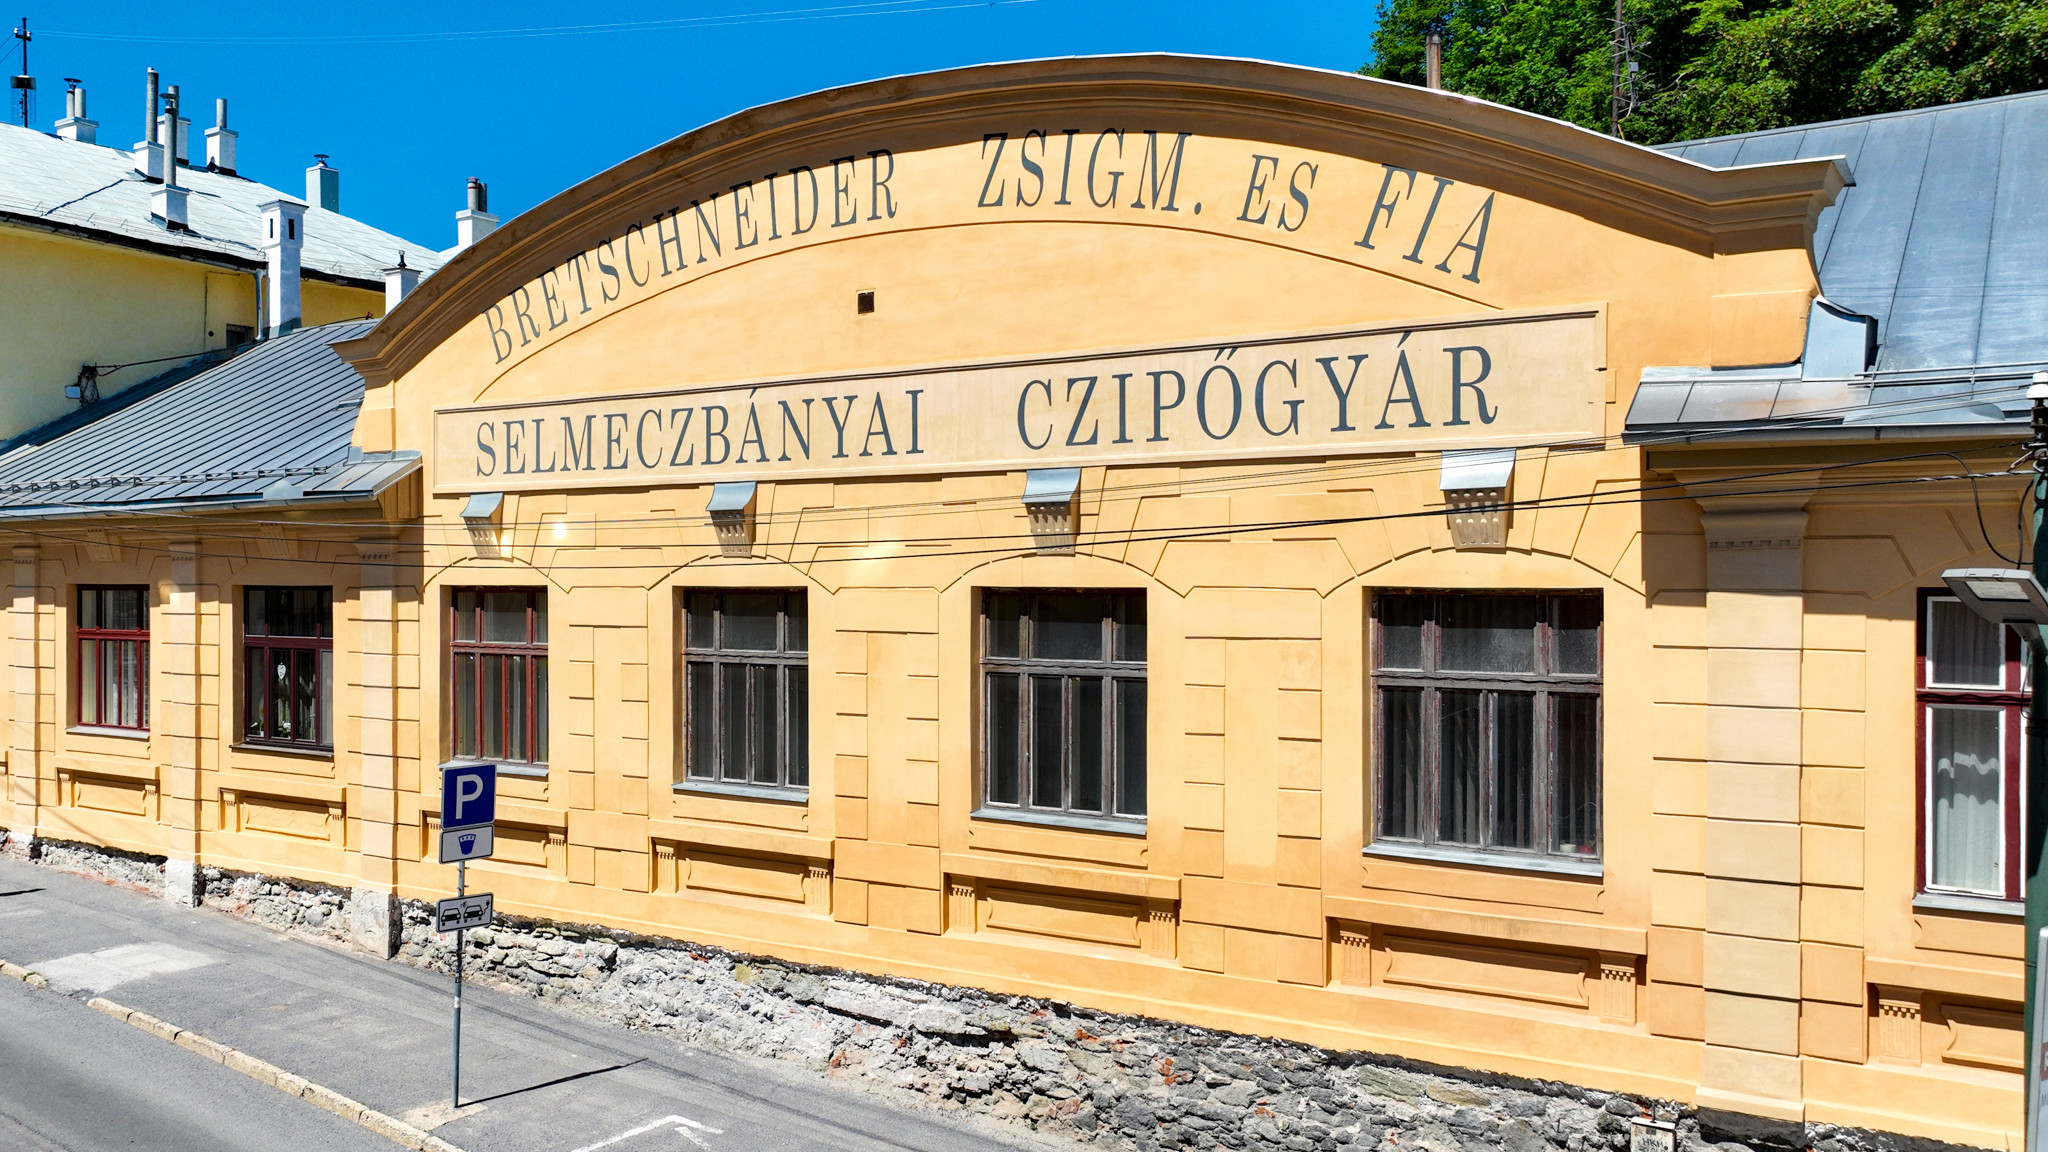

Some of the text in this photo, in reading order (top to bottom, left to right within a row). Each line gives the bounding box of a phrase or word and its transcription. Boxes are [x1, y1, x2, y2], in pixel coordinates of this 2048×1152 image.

[481, 127, 1496, 365] BRETSCHNEIDER ZSIGM. ES FIA
[476, 331, 1499, 477] SELMECZBÁNYAI CZIPŐGYÁR
[455, 773, 484, 820] P
